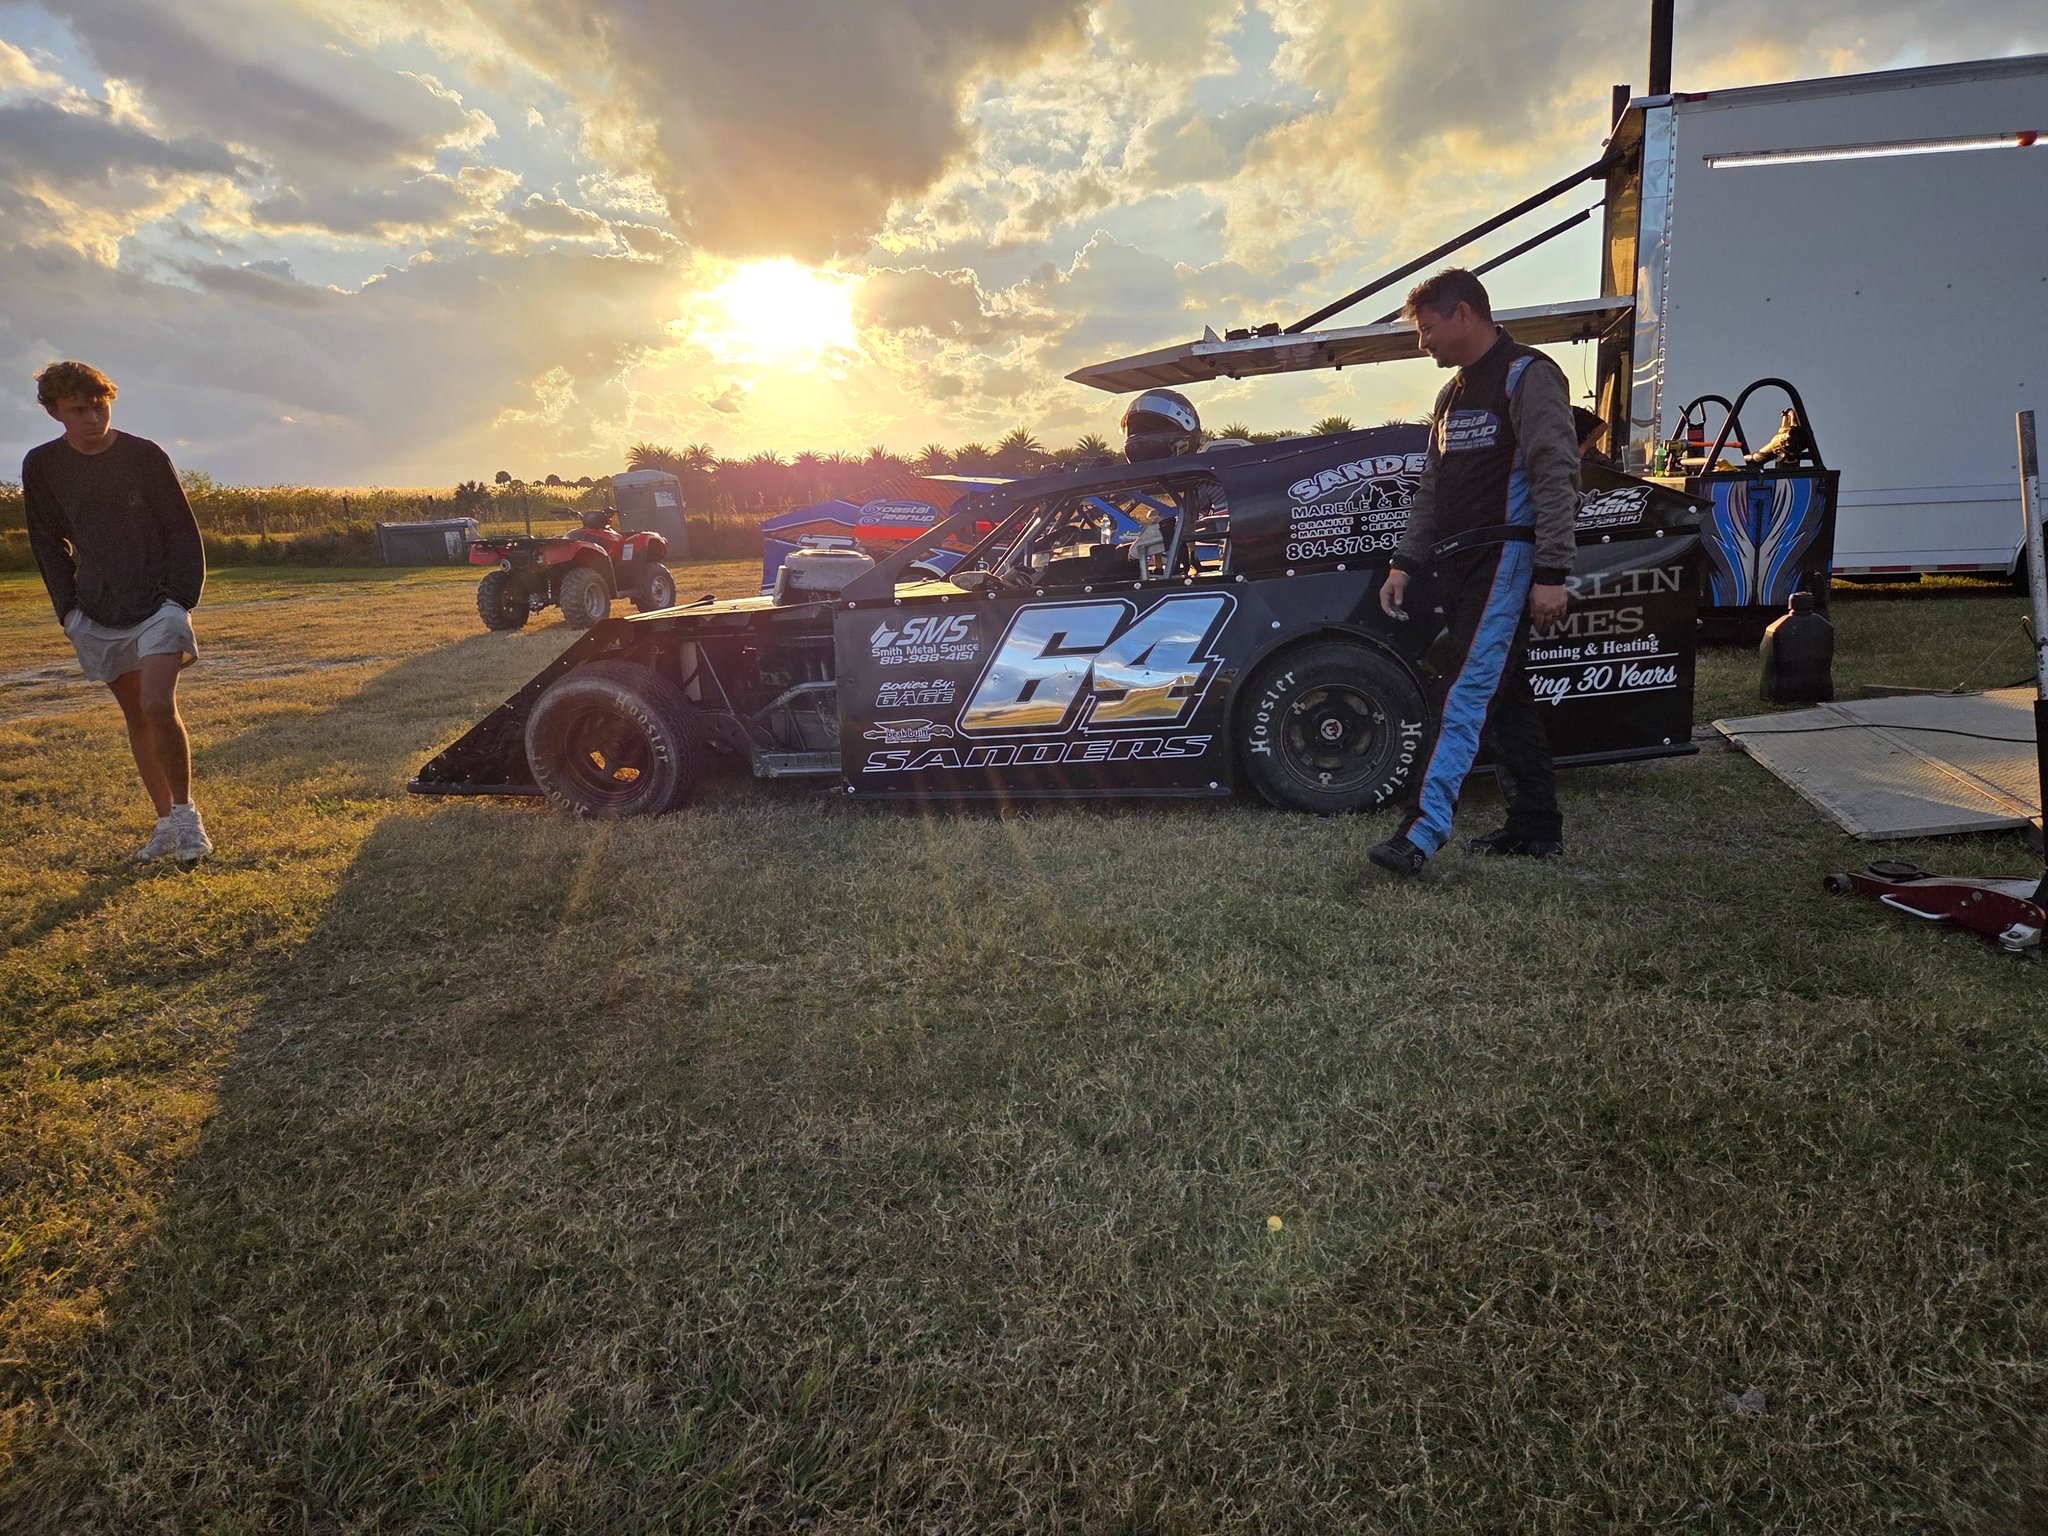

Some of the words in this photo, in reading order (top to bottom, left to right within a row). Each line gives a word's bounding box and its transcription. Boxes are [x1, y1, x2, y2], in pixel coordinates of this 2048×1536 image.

[1447, 412, 1488, 429] astal
[1289, 453, 1428, 503] SANDE
[1292, 501, 1370, 519] MARBLE
[1377, 497, 1392, 509] &
[1298, 517, 1353, 530] GRANITE
[1369, 510, 1410, 522] QUART
[1298, 527, 1351, 539] MARBLE
[1564, 566, 1684, 600] RLIN
[895, 614, 976, 646] SMS
[872, 647, 902, 657] Smith
[906, 645, 936, 655] Metal
[940, 643, 979, 653] Source
[880, 652, 974, 665] 813-988-4151
[1527, 646, 1580, 661] itioning
[1584, 643, 1598, 656] &
[1603, 638, 1659, 654] Heating
[956, 591, 1238, 738] 64
[880, 681, 928, 691] Bodies
[932, 679, 955, 690] By:
[1577, 666, 1613, 691] 30
[1618, 663, 1678, 688] Years
[876, 688, 955, 707] GAGE
[1249, 671, 1296, 757] Hoosier
[863, 735, 1213, 772] SANDERS
[1373, 719, 1423, 803] Hoosier
